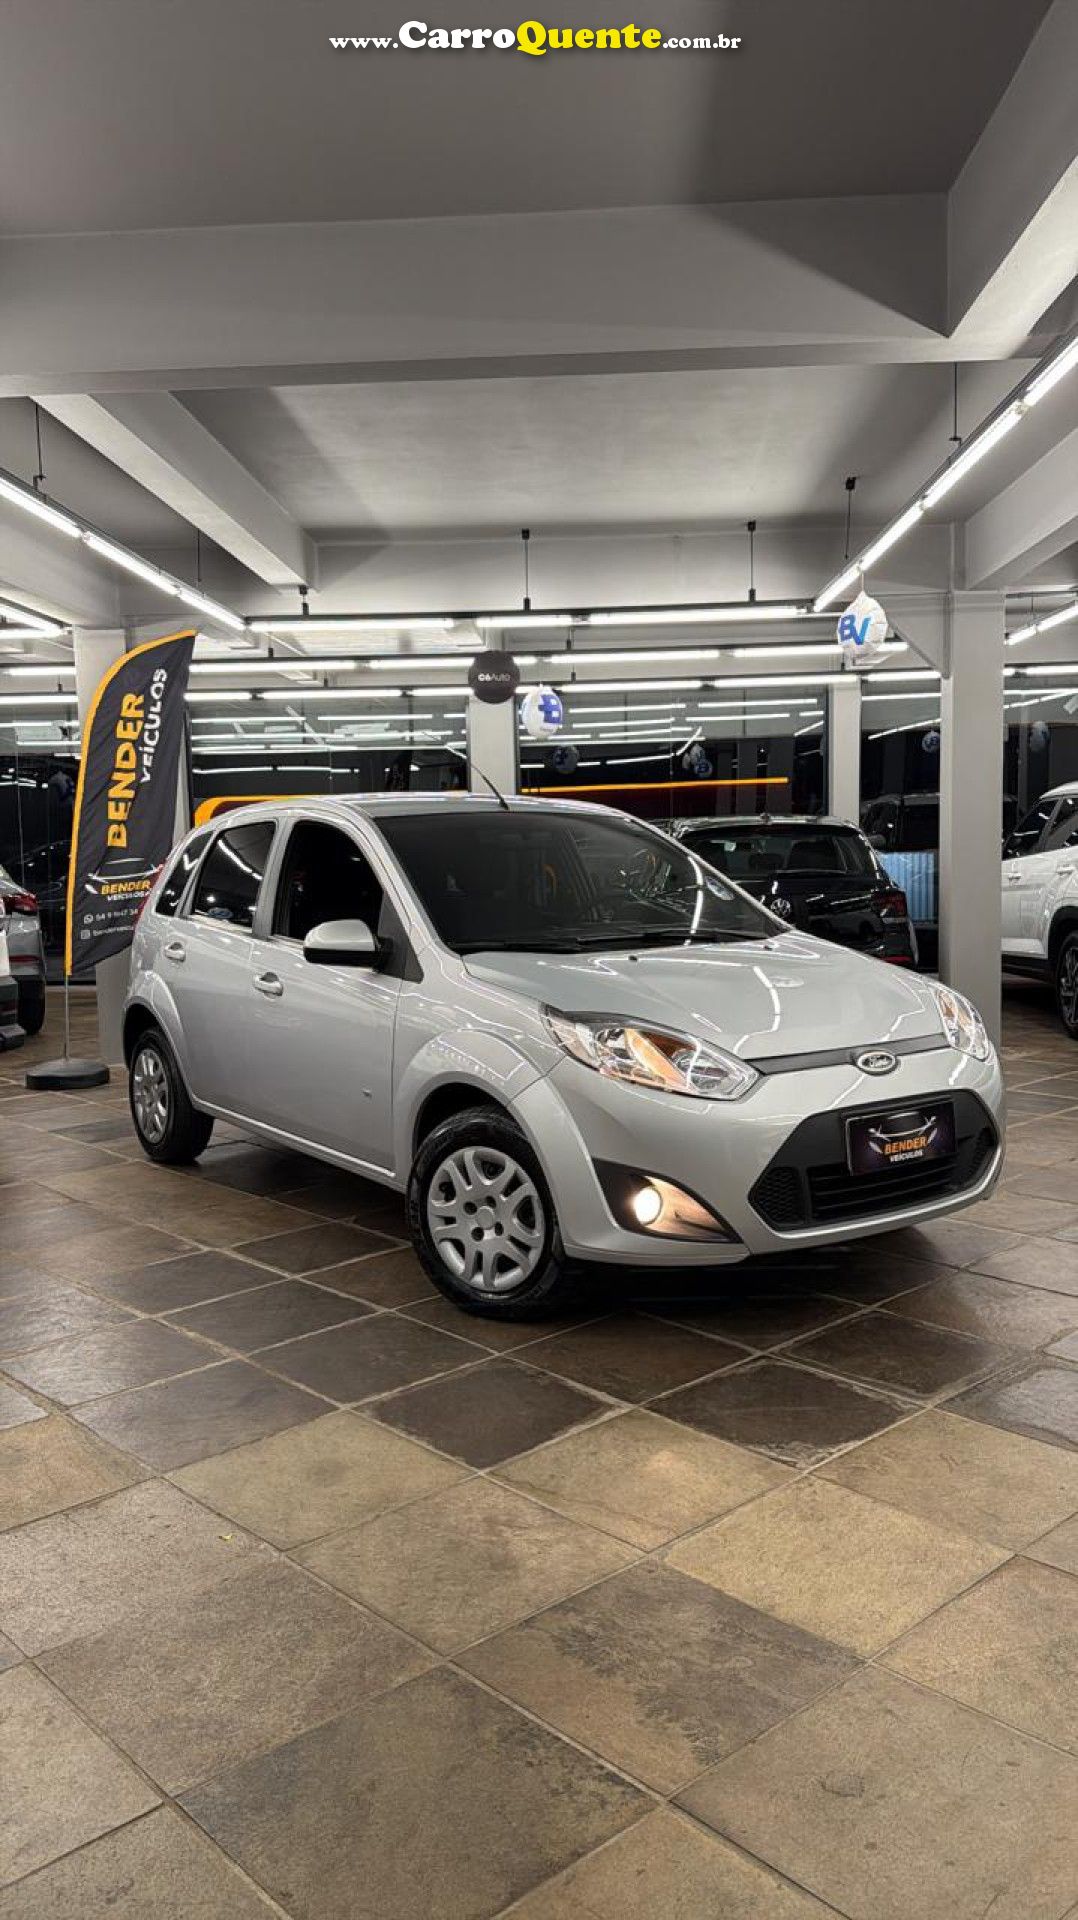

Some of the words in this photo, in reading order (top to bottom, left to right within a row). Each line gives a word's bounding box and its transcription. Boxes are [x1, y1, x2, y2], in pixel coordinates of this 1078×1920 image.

[839, 614, 871, 646] BV
[107, 693, 145, 847] BENDER
[101, 880, 151, 895] BENDER
[885, 1137, 927, 1154] BENDER
